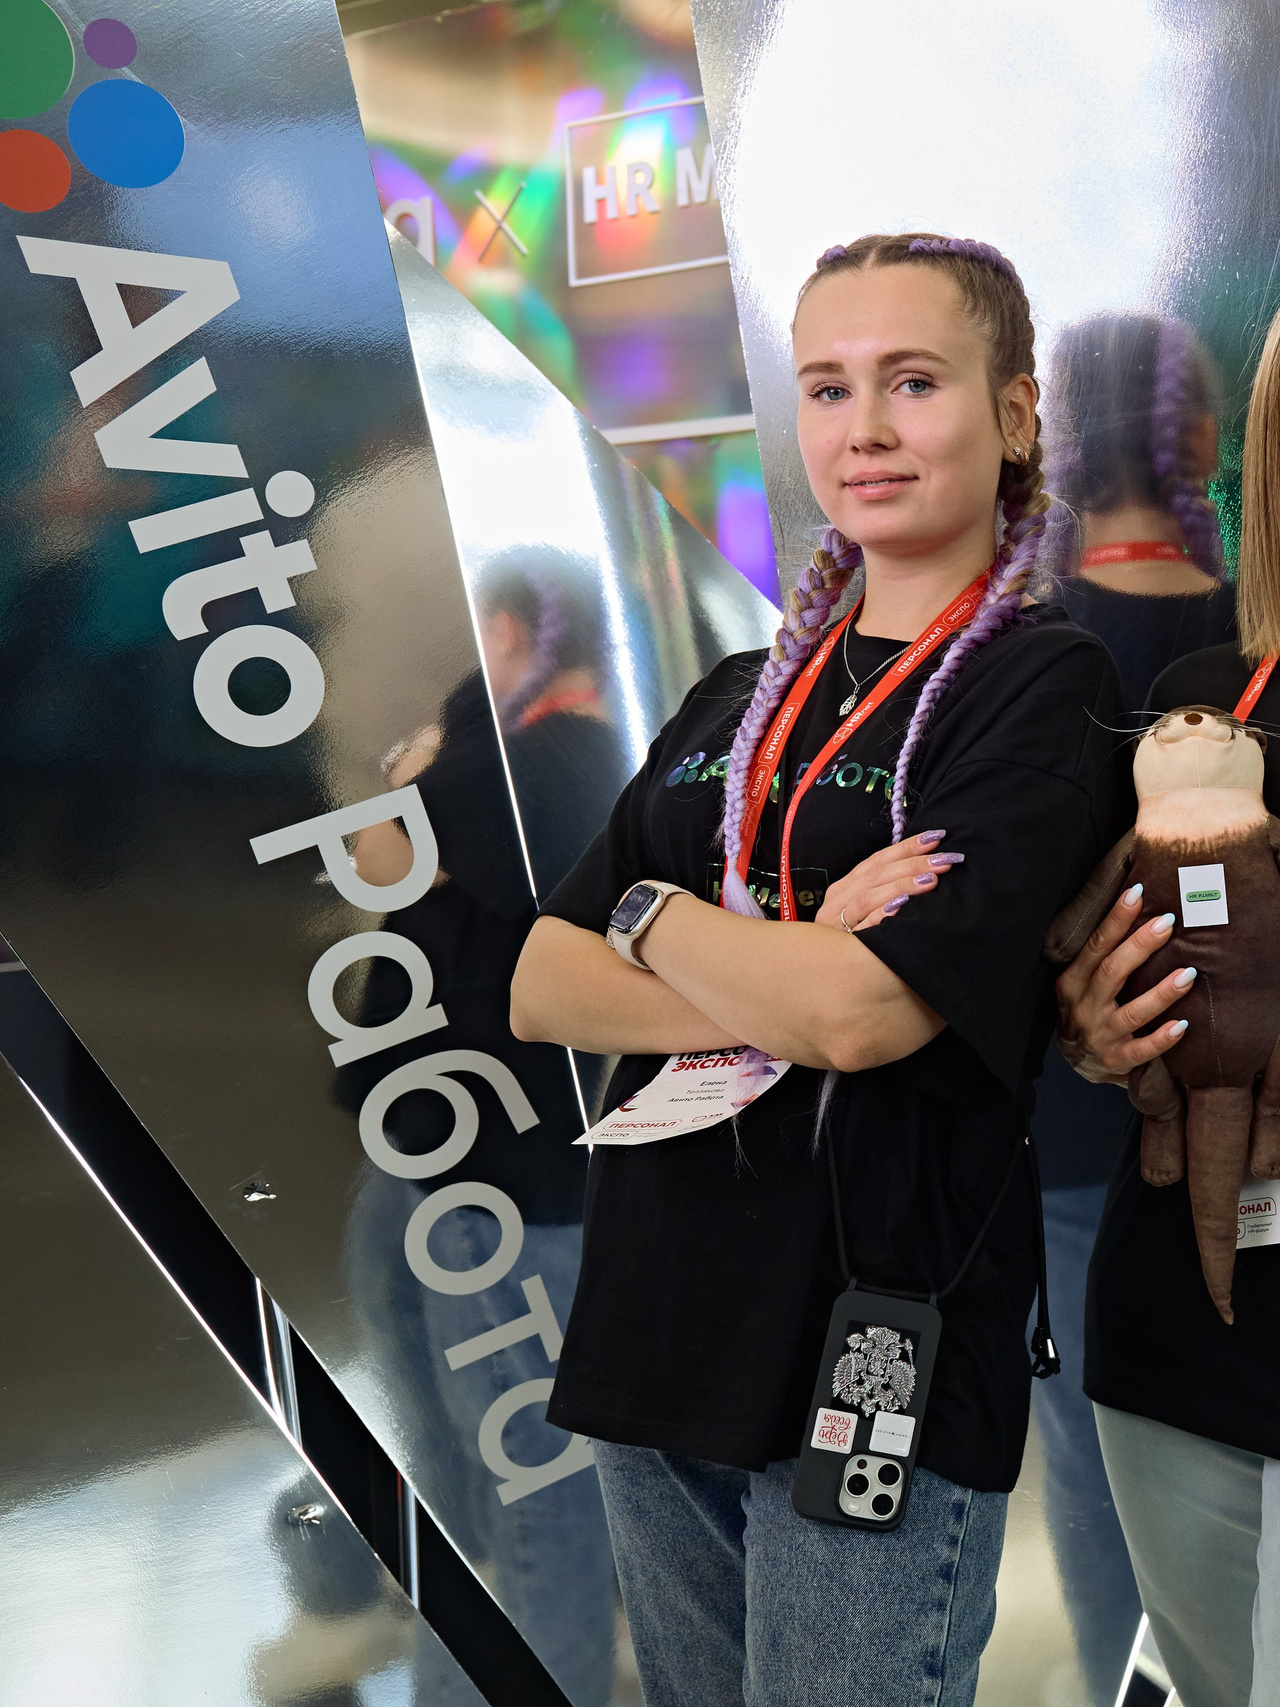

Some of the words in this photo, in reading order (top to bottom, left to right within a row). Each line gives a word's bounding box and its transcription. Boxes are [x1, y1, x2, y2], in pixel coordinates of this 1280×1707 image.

[582, 160, 662, 225] HR
[947, 601, 970, 623] ЭКСПО
[897, 627, 944, 673] ПЕРСОНАЛ
[764, 706, 795, 760] ПЕРСОНАЛ
[751, 769, 766, 797] ЭКСПО
[15, 235, 325, 748] Avito
[249, 784, 597, 1506] Работа
[608, 1121, 677, 1129] ПЕРСОНАЛ
[1239, 1202, 1271, 1215] ОНАЛ
